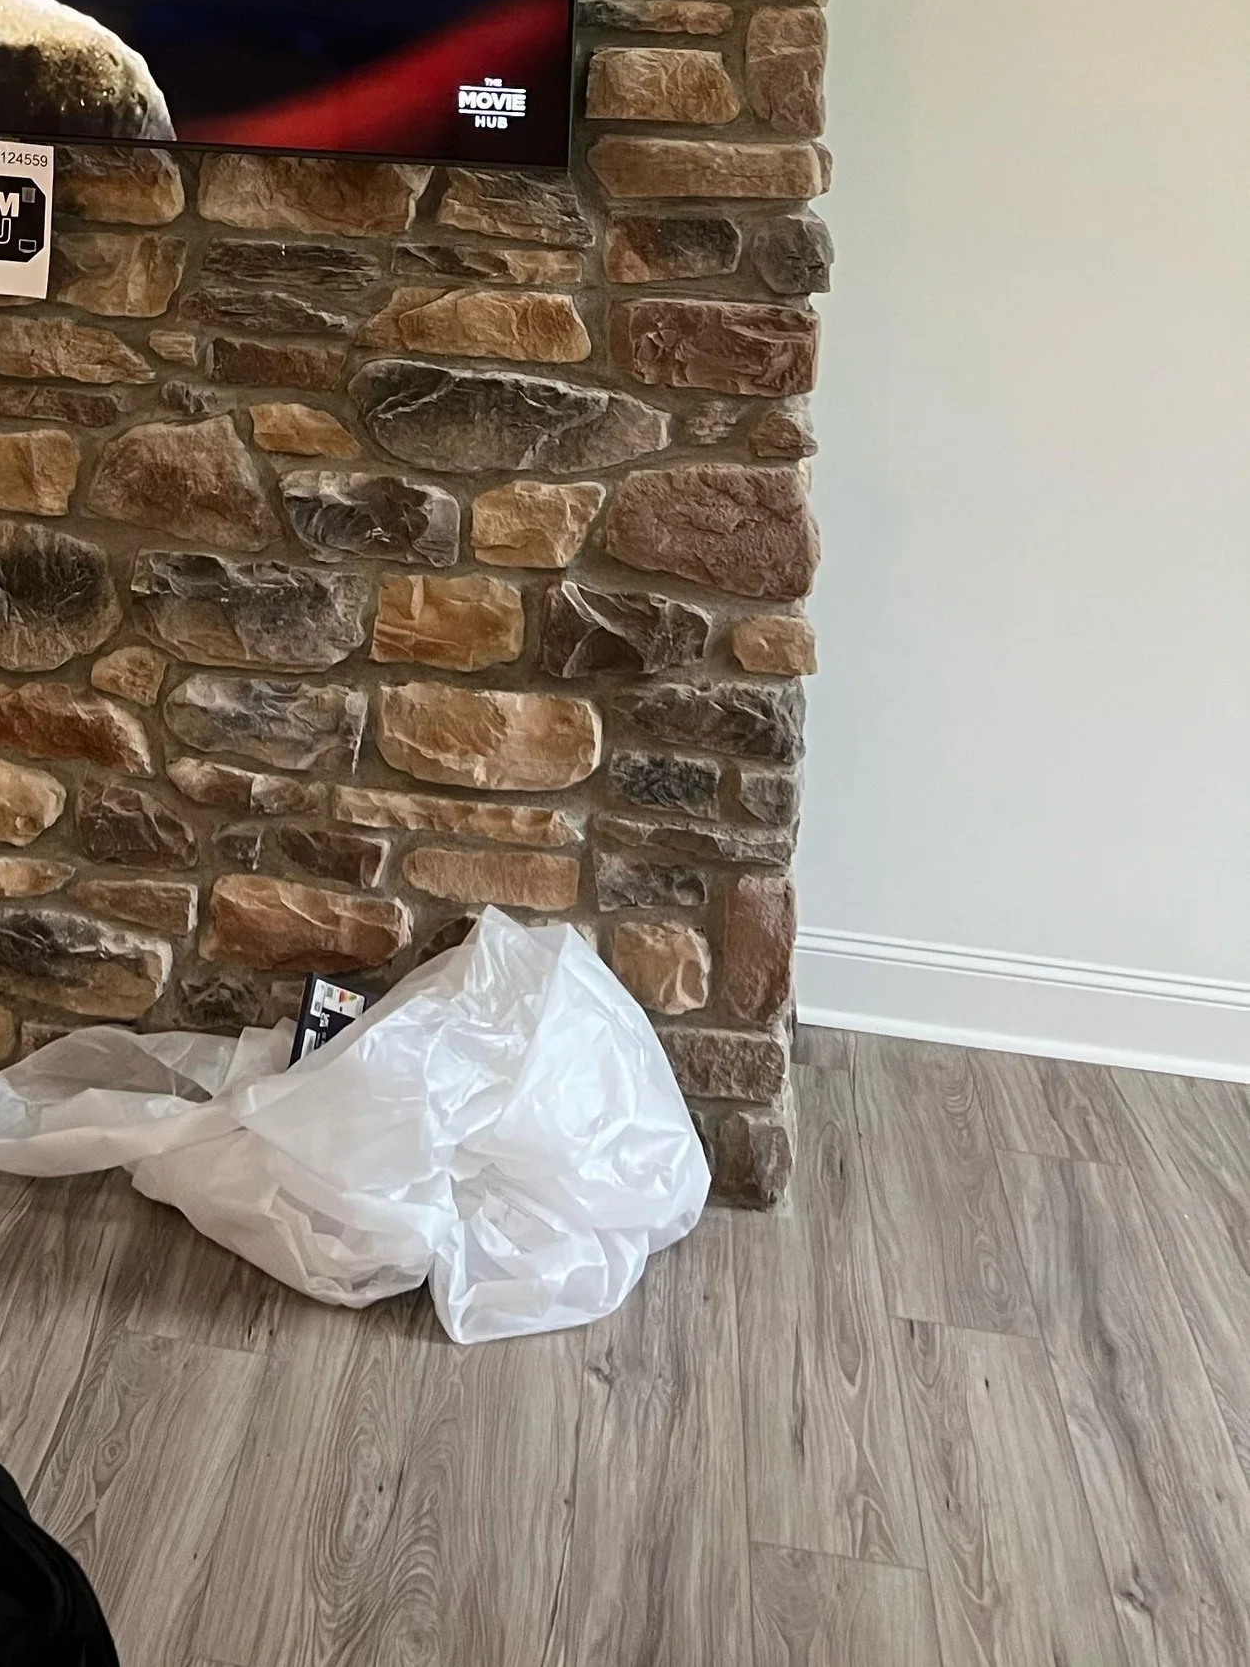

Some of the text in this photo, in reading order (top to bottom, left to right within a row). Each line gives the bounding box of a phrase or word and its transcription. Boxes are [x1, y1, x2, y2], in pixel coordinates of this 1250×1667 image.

[484, 77, 503, 87] THE
[458, 91, 526, 111] MOVIE
[474, 115, 508, 129] HUB
